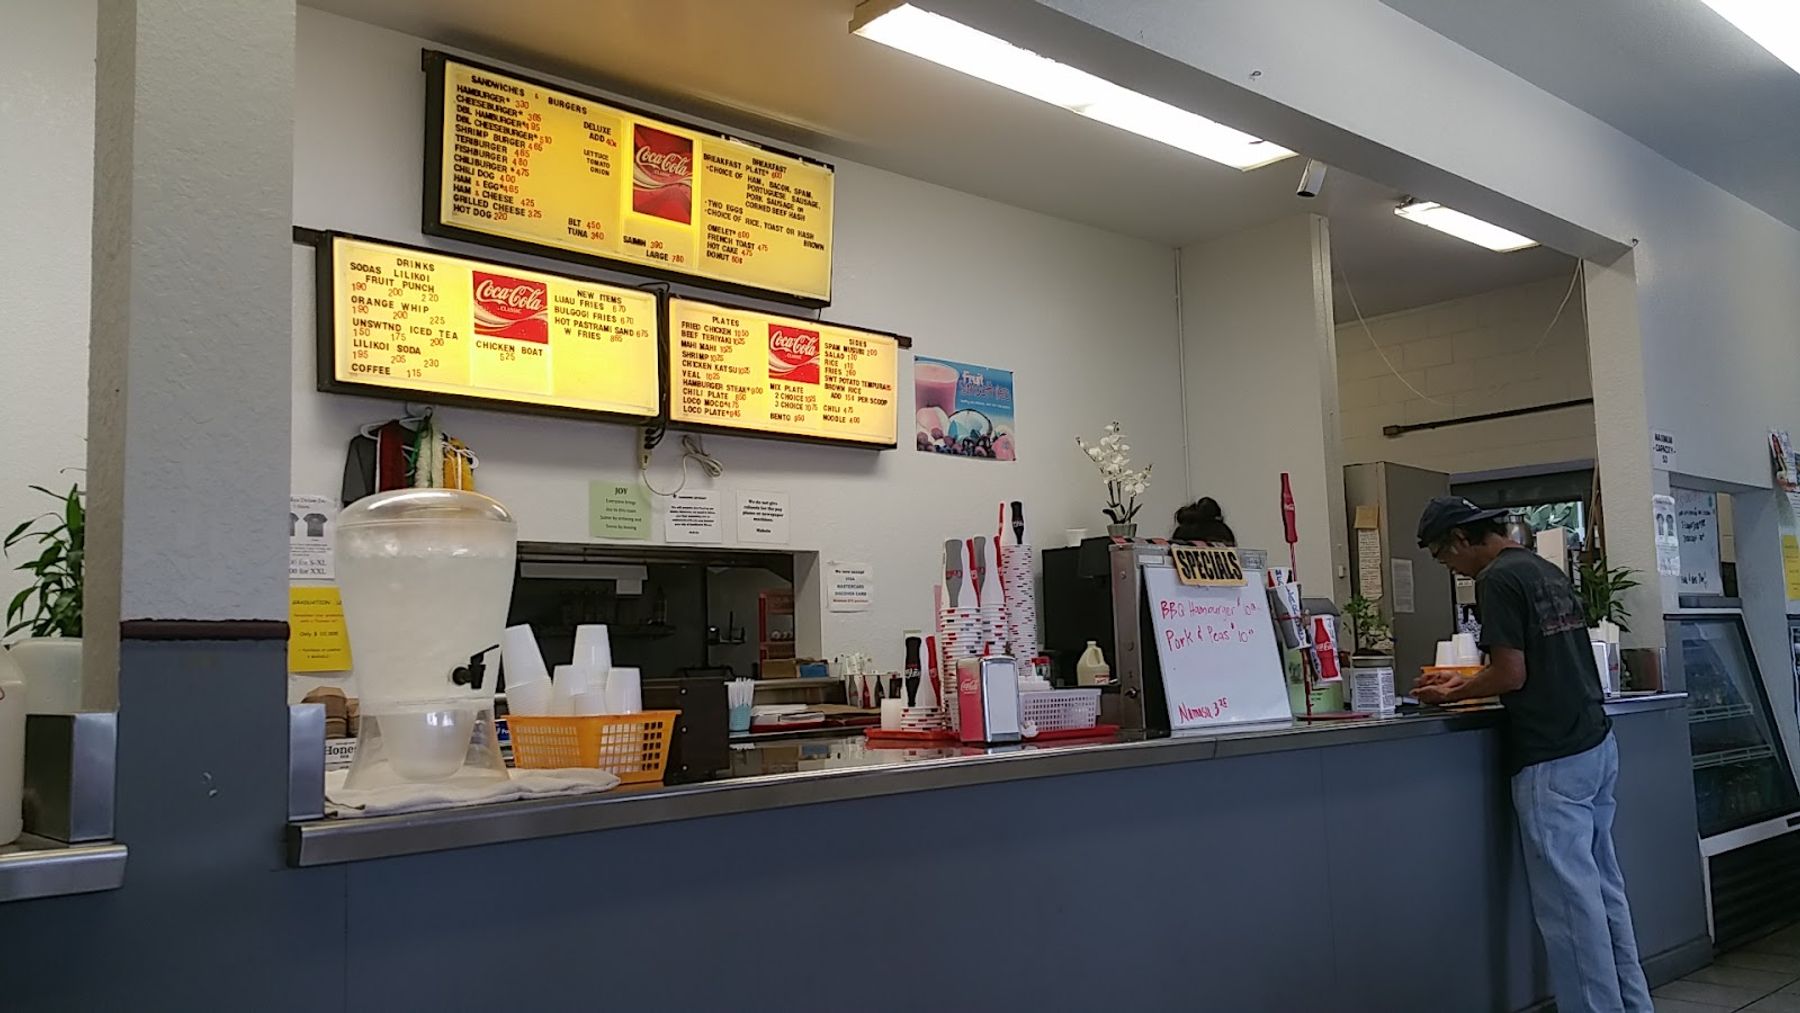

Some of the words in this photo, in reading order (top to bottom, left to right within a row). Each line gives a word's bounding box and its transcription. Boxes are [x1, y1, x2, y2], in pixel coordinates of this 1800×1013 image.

[472, 76, 524, 96] SANDWICHES
[548, 97, 587, 114] BURGERS
[457, 105, 472, 115] DBL
[456, 114, 471, 124] DBL
[584, 122, 611, 135] DELUXE
[456, 124, 488, 137] SHRIMP
[493, 134, 525, 148] BURGER
[589, 133, 604, 142] ADD
[456, 134, 507, 153] TERIBURGER
[455, 144, 507, 164] FISHBURGER
[584, 149, 608, 160] LETTUCE
[586, 158, 610, 168] TOMATO
[636, 146, 690, 176] Coca-Cola
[704, 153, 741, 170] BREAKFAST
[752, 158, 787, 173] BREAKFAST
[454, 164, 474, 175] CHILI
[478, 169, 494, 179] DOG
[590, 167, 609, 176] ONION
[735, 172, 743, 180] OF
[454, 174, 471, 184] HAM
[454, 184, 471, 194] HAM
[482, 191, 514, 204] CHEESE
[747, 184, 786, 200] PORTUGUESE
[453, 194, 488, 208] GRILLED
[493, 202, 525, 216] CHEESE
[453, 204, 470, 214] HOT
[473, 208, 491, 218] DOG
[726, 204, 743, 214] EGGS
[767, 198, 794, 211] SAUSAGE
[745, 201, 770, 213] CORNED
[772, 207, 788, 217] BEEF
[789, 212, 805, 222] HASH
[568, 218, 581, 227] BLT
[587, 221, 600, 229] 450
[568, 227, 587, 238] TUNA
[764, 222, 784, 233] TOAST
[797, 230, 814, 240] HASH
[707, 233, 733, 245] FRENCH
[736, 239, 755, 250] TOAST
[803, 239, 824, 250] BROWN
[707, 242, 720, 251] HOT
[722, 245, 738, 255] CAKE
[646, 250, 668, 261] LARGE
[707, 250, 729, 261] DONUT
[397, 258, 435, 272] DRINKS
[350, 262, 381, 274] SODAS
[394, 269, 430, 282] LILIKOI
[366, 275, 394, 287] FRUIT
[402, 281, 435, 293] PUNCH
[352, 282, 367, 291] 190
[388, 288, 402, 297] 200
[421, 294, 439, 302] 220
[476, 280, 545, 310] Coca-Cola
[577, 290, 594, 299] NEW
[600, 294, 622, 304] ITEMS
[351, 295, 394, 309] ORANGE
[401, 302, 429, 313] WHIP
[555, 295, 575, 304] LUAU
[580, 300, 604, 310] FRIES
[352, 306, 369, 314] 190
[393, 311, 408, 320] 200
[430, 317, 445, 325] 225
[554, 306, 589, 318] BULGOGI
[593, 313, 617, 323] FRIES
[555, 317, 570, 326] HOT
[574, 320, 612, 333] PASTRAMI
[615, 327, 634, 336] SAND
[681, 321, 701, 330] FRIED
[704, 325, 731, 335] CHICKEN
[713, 316, 739, 327] PLATES
[353, 318, 402, 332] UNSWTND
[410, 326, 432, 336] ICED
[439, 330, 458, 340] TEA
[578, 330, 601, 340] FRIES
[354, 328, 370, 337] 150
[430, 338, 444, 347] 200
[681, 330, 698, 338] BEEF
[702, 333, 731, 344] TERIYAKI
[770, 331, 819, 356] Coca-Cola
[354, 339, 389, 351] LILIKOI
[397, 345, 421, 355] SODA
[476, 340, 515, 352] CHICKEN
[522, 347, 543, 356] BOAT
[681, 340, 696, 349] MAHI
[699, 343, 716, 351] MAHI
[353, 351, 368, 359] 195
[424, 359, 439, 368] 230
[500, 352, 515, 362] 525
[682, 351, 709, 359] SHRIMP
[825, 351, 844, 359] SALAD
[352, 363, 391, 375] COFFEE
[407, 369, 421, 378] 115
[682, 360, 712, 370] CHICKEN
[715, 365, 738, 373] KATSU
[825, 367, 842, 375] FRIES
[683, 370, 700, 379] VEAL
[683, 379, 723, 390] HAMBURGER
[825, 383, 845, 391] BROWN
[839, 377, 859, 386] POTATO
[683, 388, 703, 396] CHILI
[708, 391, 728, 399] PLATE
[785, 385, 803, 393] PLATE
[683, 397, 701, 405] LOCO
[781, 393, 803, 402] CHOICE
[683, 406, 702, 414] LOCO
[781, 402, 803, 410] CHOICE
[770, 413, 790, 421] BENTO
[823, 415, 845, 423] NOODLE
[1176, 550, 1242, 580] SPECIALS
[324, 746, 357, 755] Hone
